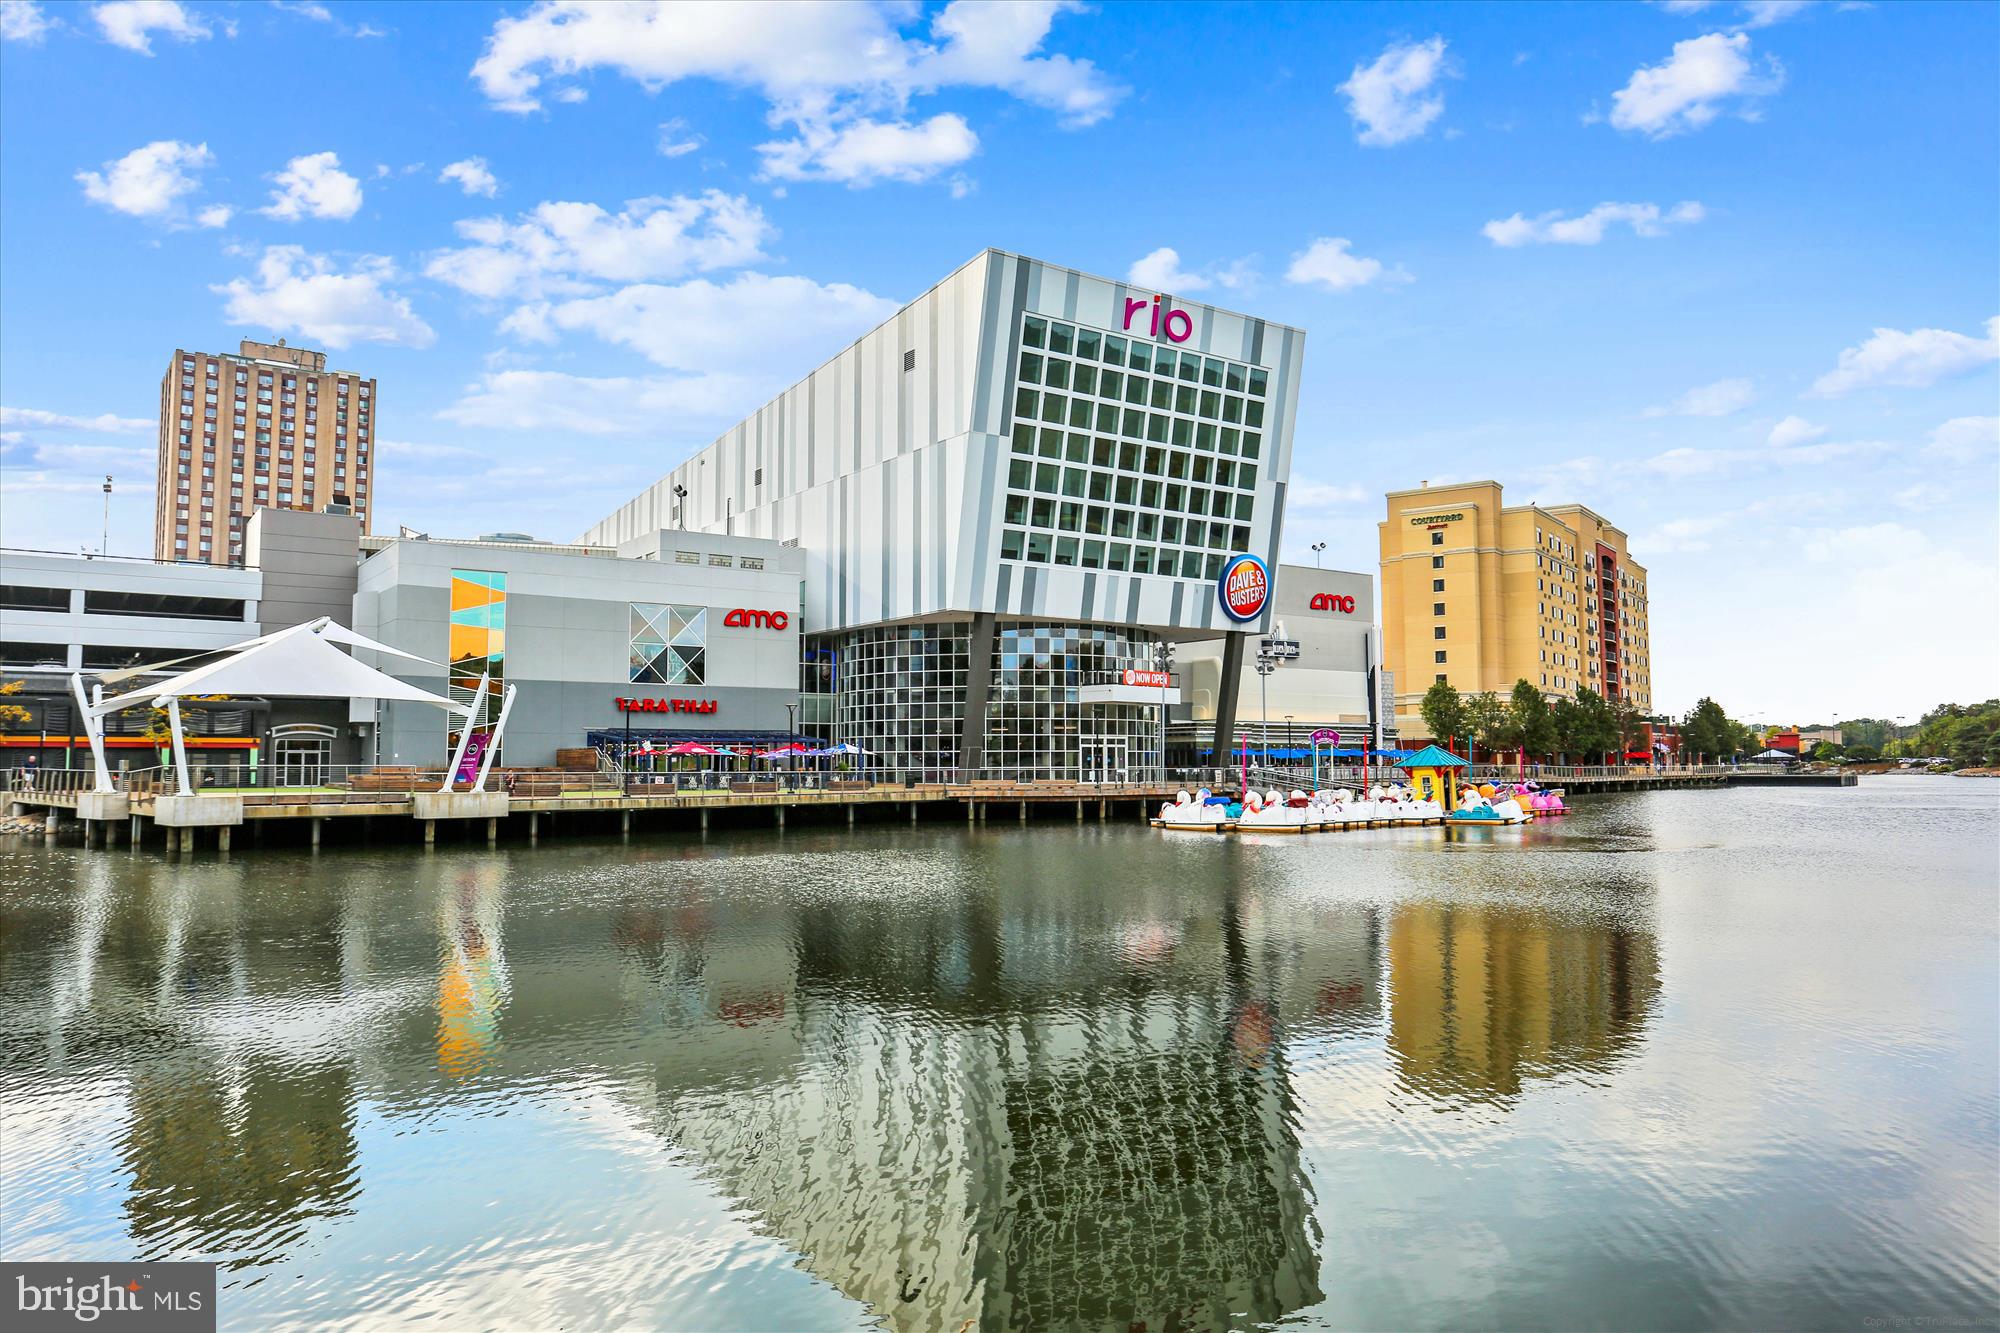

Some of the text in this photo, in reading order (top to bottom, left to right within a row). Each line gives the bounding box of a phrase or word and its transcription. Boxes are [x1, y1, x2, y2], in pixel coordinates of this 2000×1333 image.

[1123, 294, 1193, 343] rio
[1410, 513, 1463, 526] COURTYARD
[1229, 570, 1265, 592] DAVE &
[1230, 585, 1265, 607] BUSTER'S
[1135, 671, 1168, 686] NOW OPEN
[615, 697, 718, 714] TARA THAI
